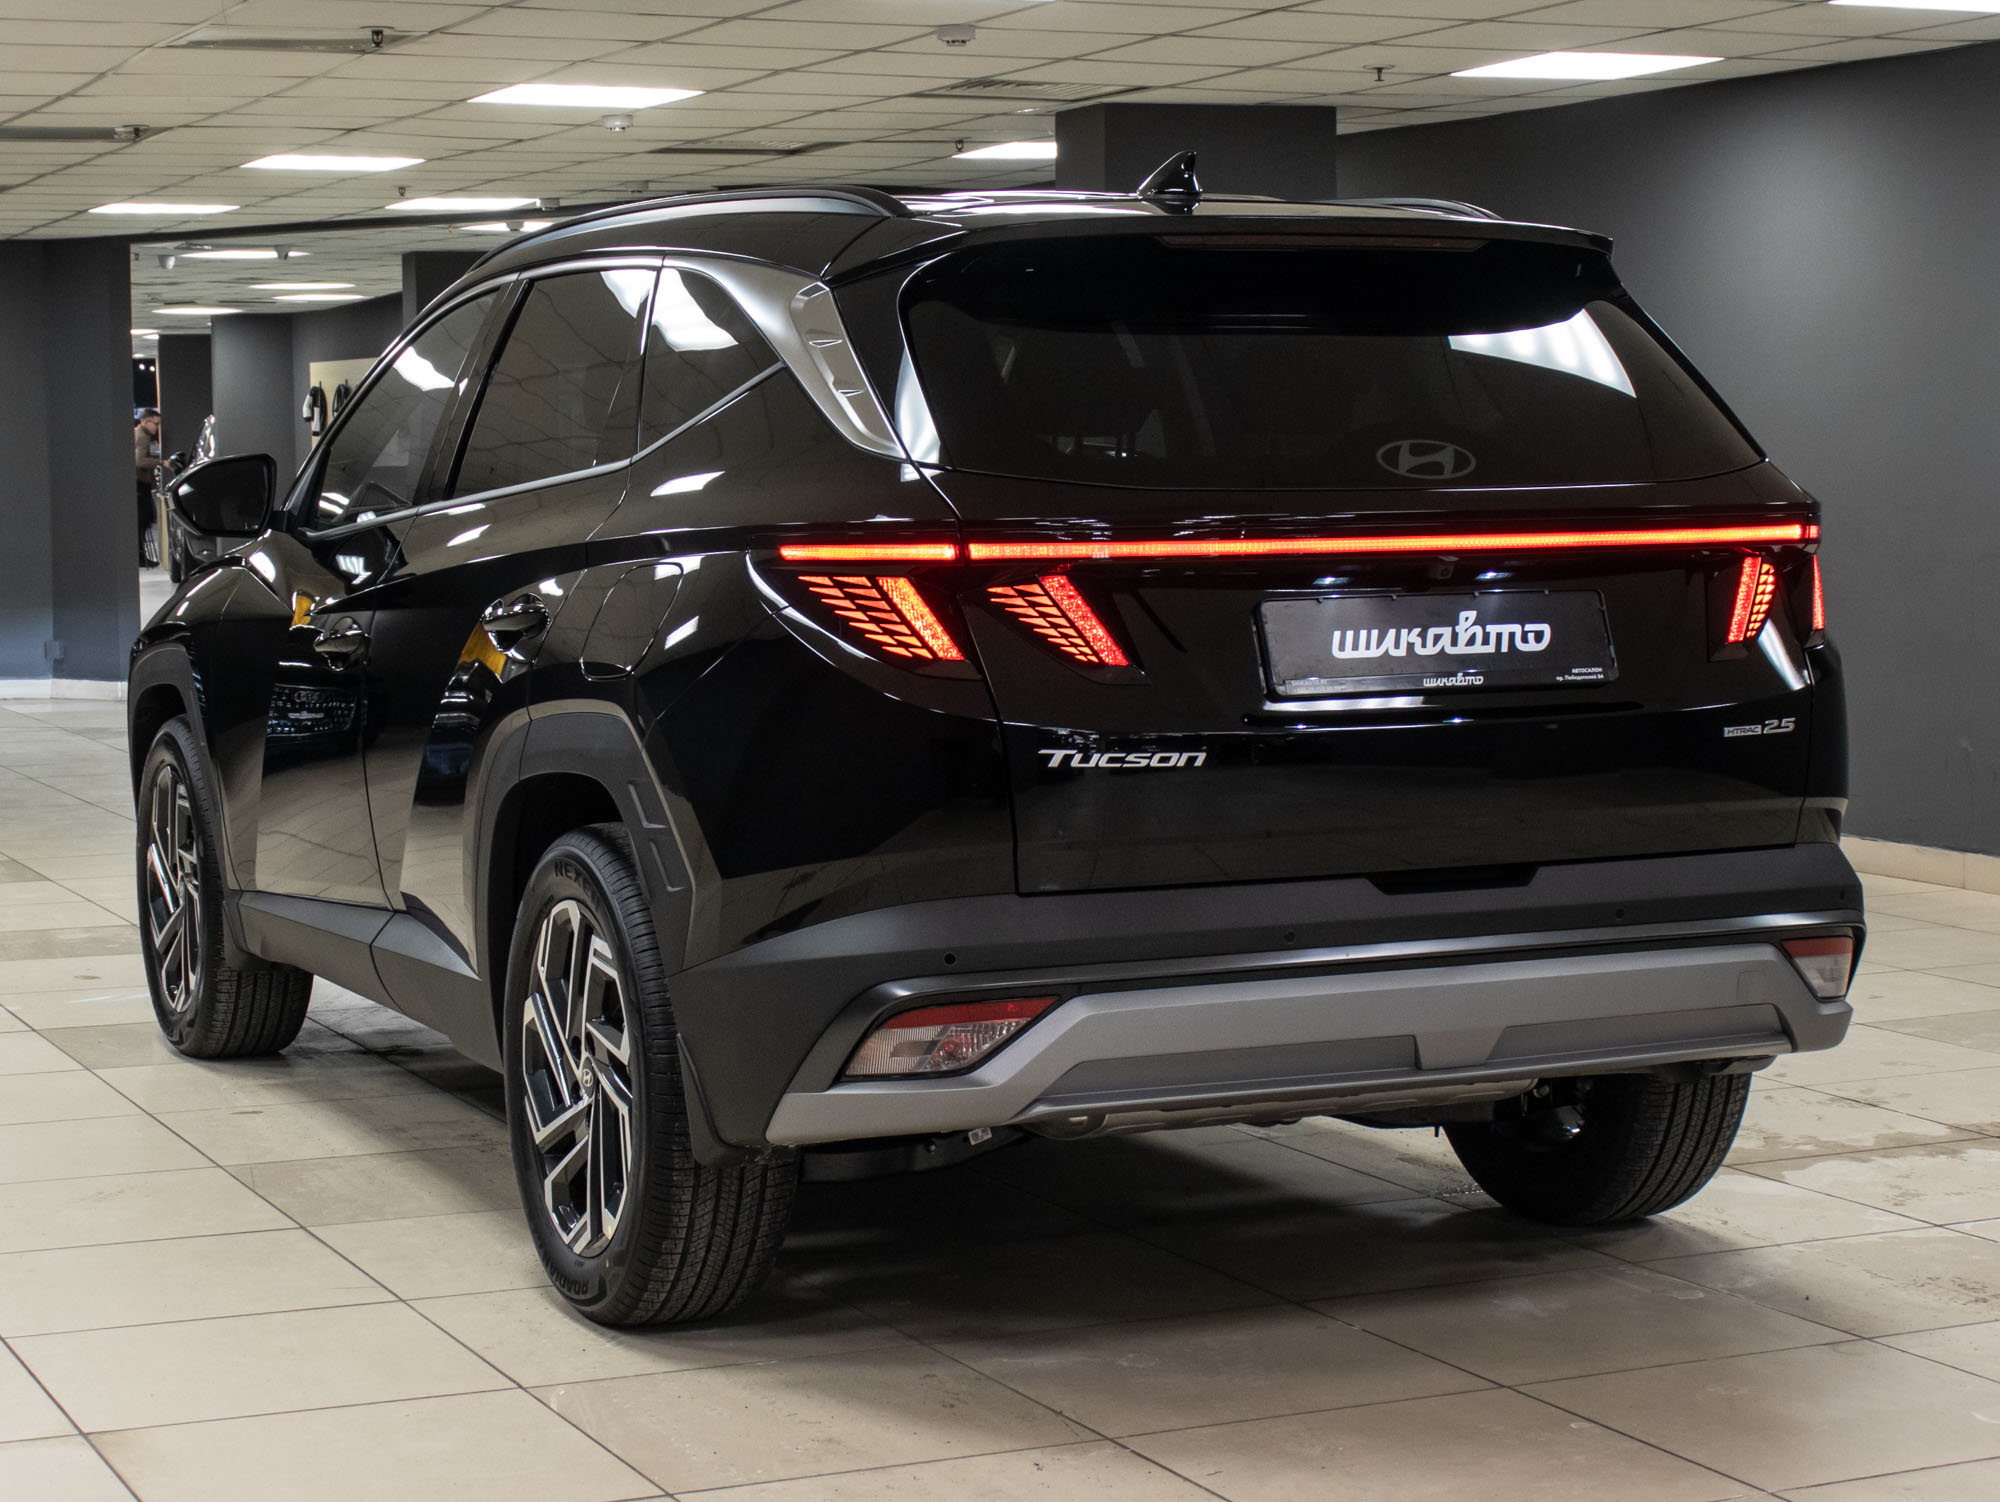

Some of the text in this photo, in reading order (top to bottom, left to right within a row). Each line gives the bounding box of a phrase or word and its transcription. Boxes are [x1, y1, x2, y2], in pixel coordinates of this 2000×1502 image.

[1331, 610, 1551, 659] шикавто
[1423, 673, 1484, 687] шикавто
[1727, 726, 1759, 735] HTRAC
